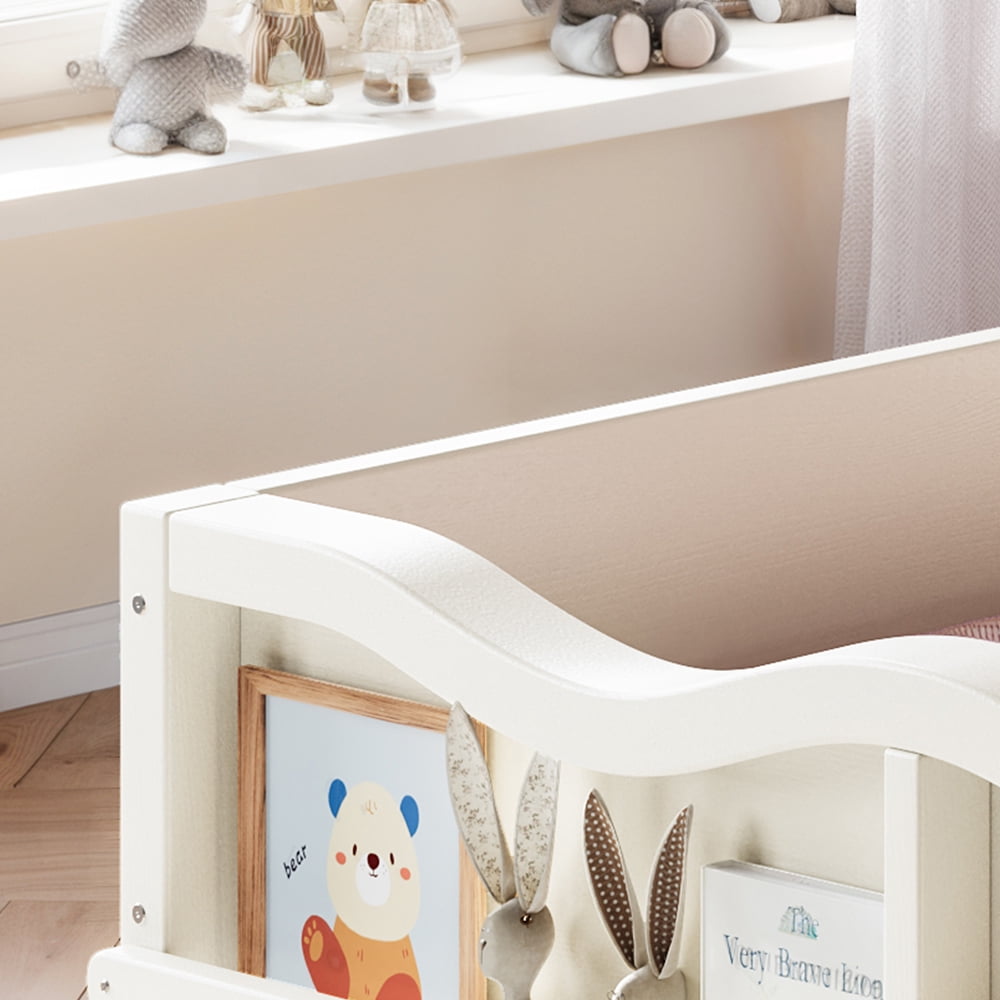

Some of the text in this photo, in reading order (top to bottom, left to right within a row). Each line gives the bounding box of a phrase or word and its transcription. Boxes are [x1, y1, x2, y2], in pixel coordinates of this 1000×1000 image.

[283, 845, 306, 879] bear
[724, 934, 767, 985] Very
[778, 947, 831, 989] Brave
